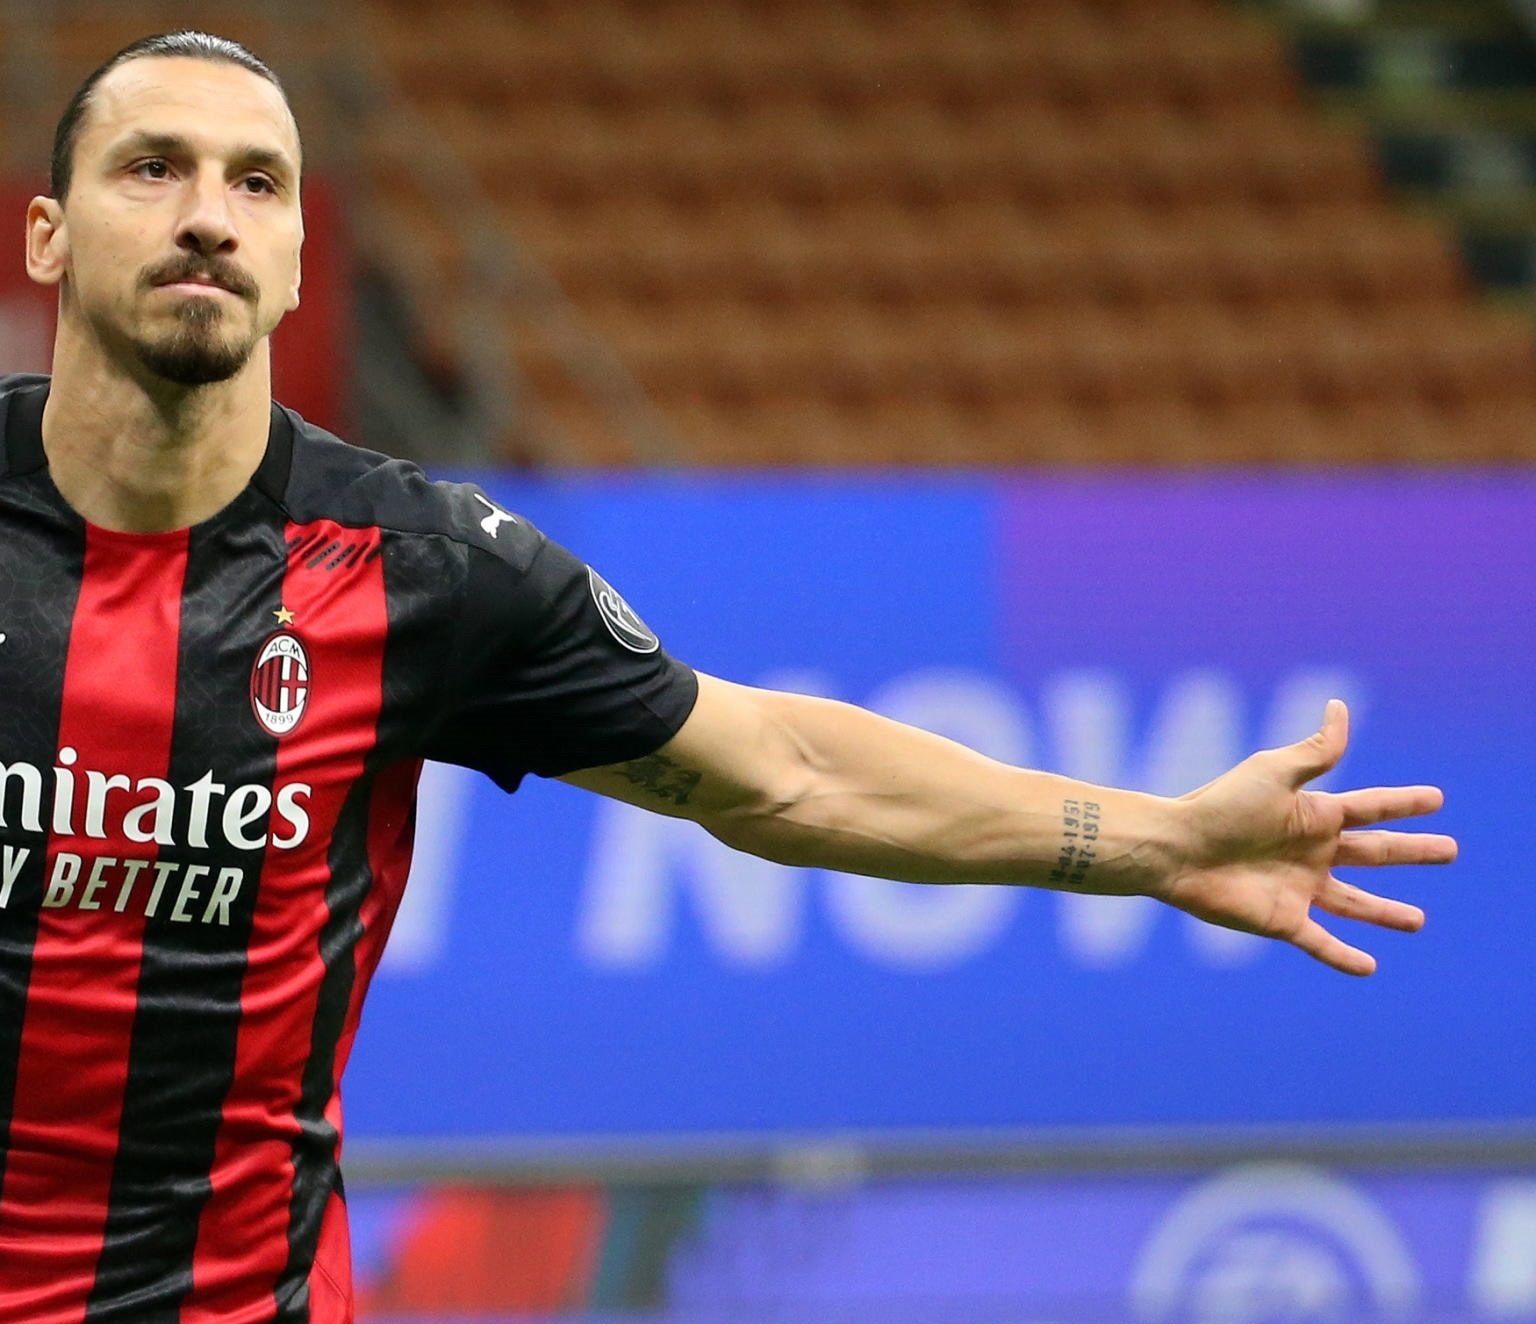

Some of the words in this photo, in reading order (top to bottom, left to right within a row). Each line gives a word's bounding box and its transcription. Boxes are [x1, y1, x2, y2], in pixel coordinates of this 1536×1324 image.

[267, 638, 302, 658] ACM
[265, 712, 295, 725] 1899
[41, 852, 244, 926] BETTER
